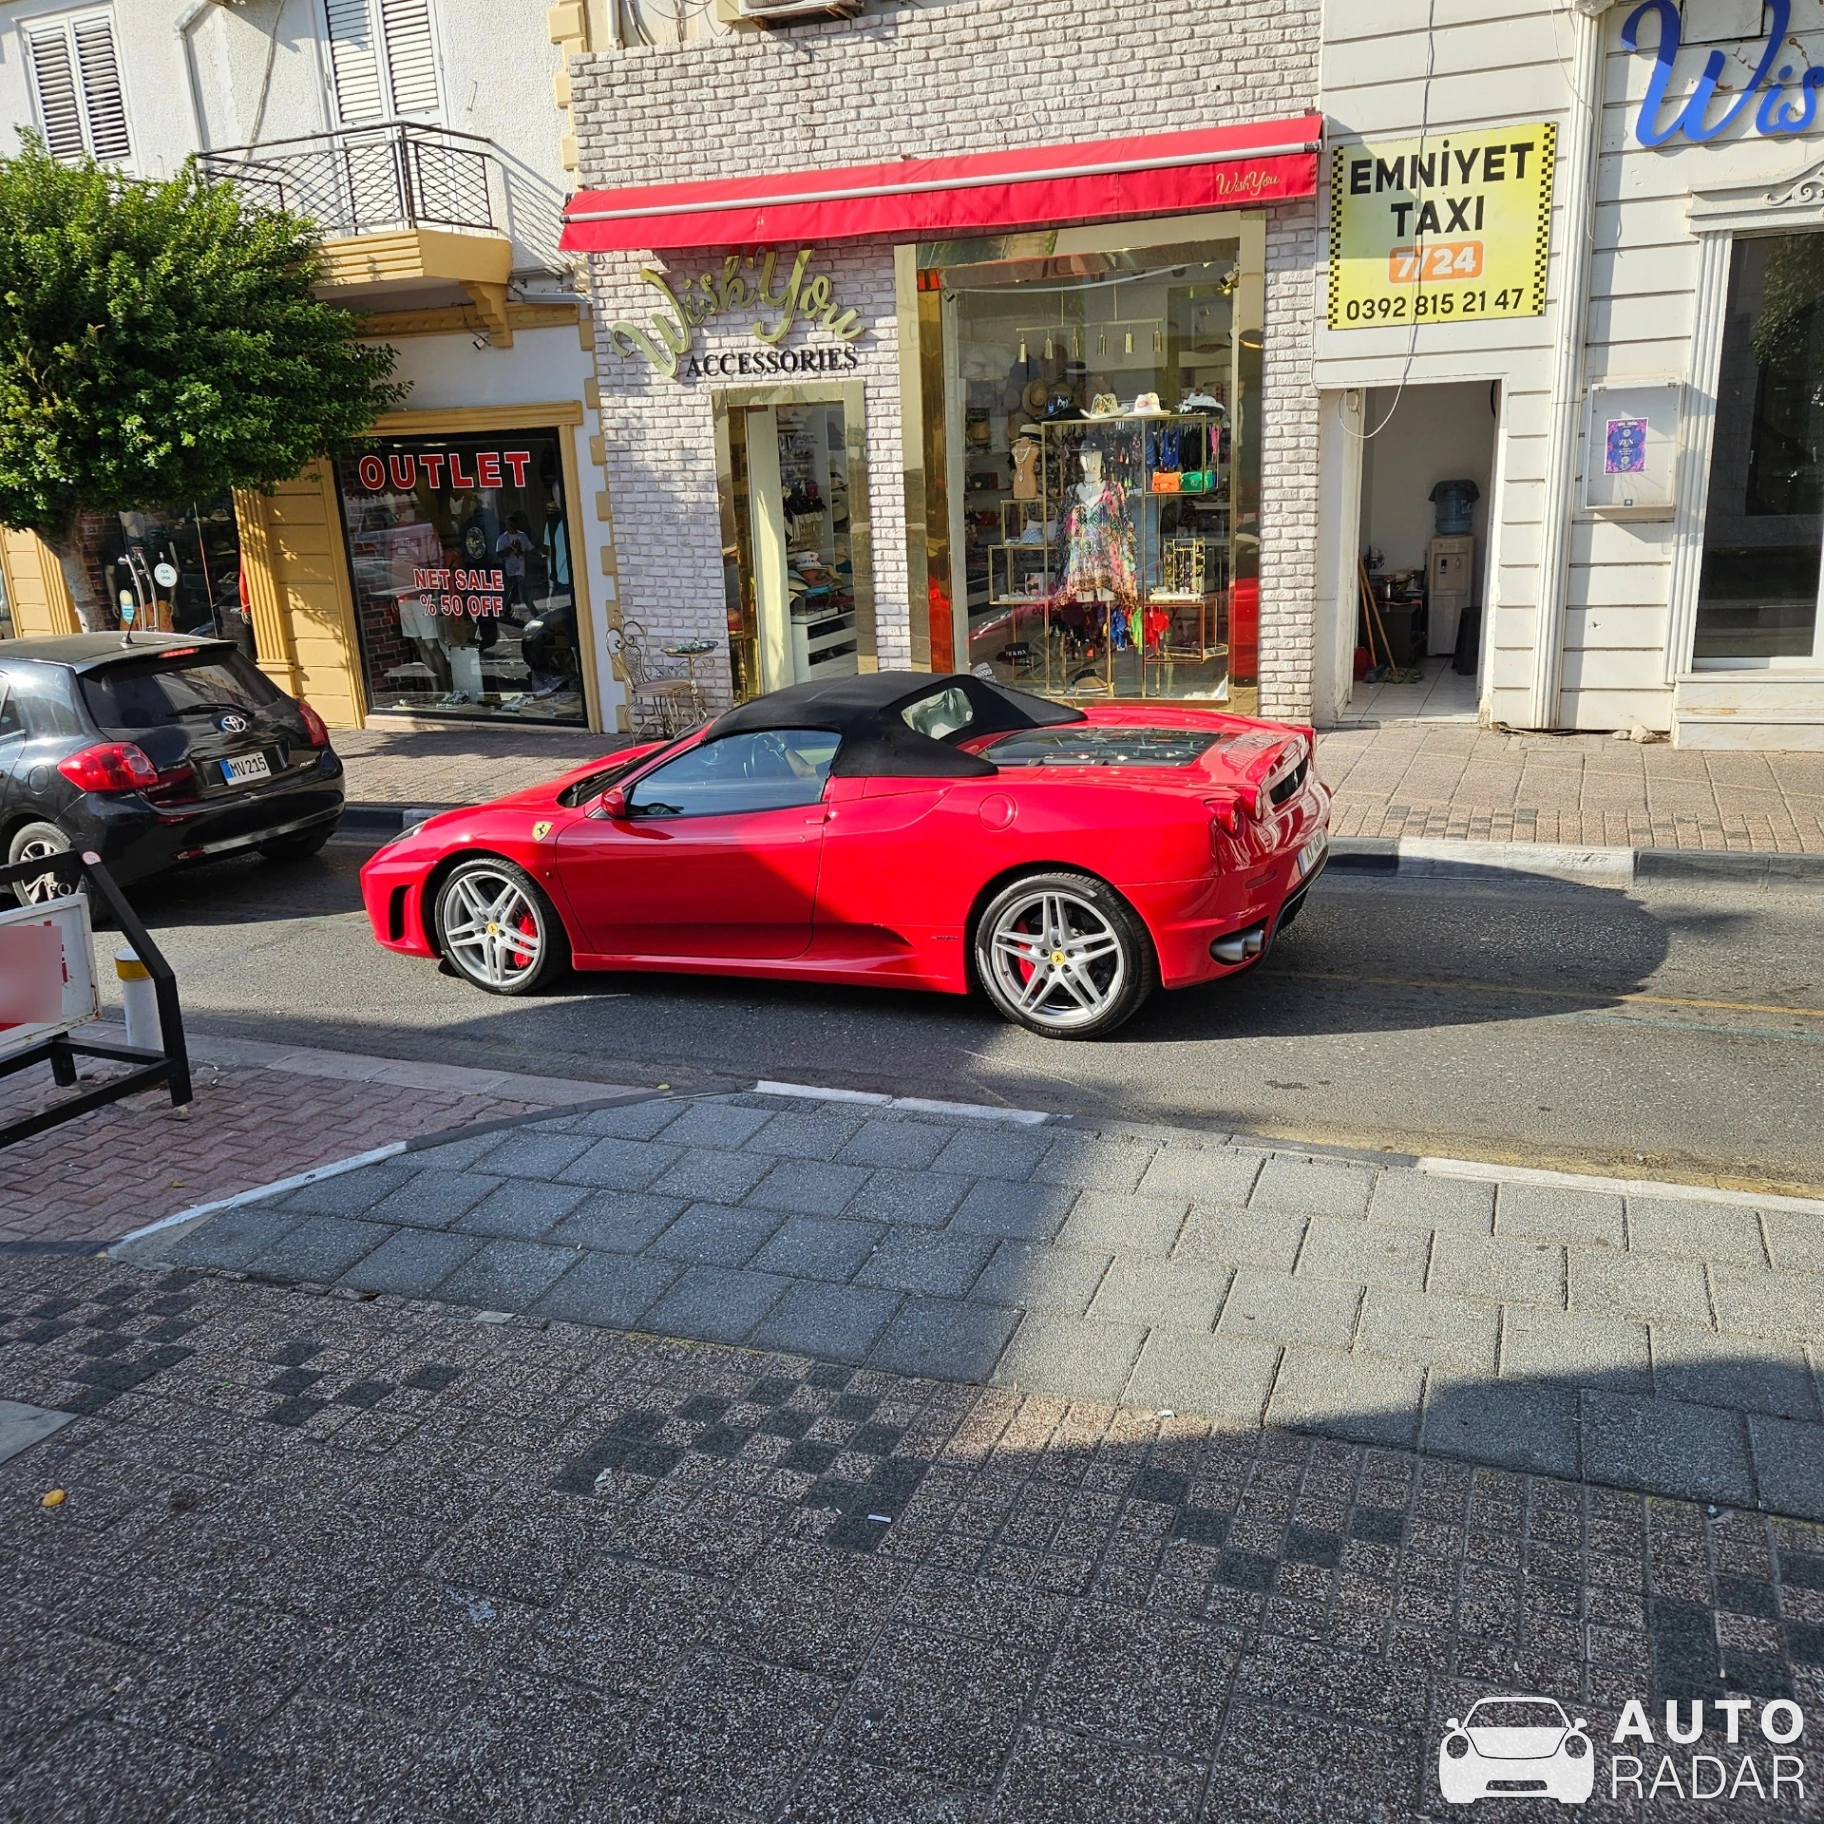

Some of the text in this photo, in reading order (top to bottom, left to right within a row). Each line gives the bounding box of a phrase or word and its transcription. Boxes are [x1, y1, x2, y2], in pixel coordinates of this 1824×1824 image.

[1350, 140, 1534, 195] EMNİYET
[1390, 195, 1485, 237] TAXI
[1396, 246, 1477, 279] 7/24
[1346, 288, 1524, 321] 0392 815 21 47
[686, 346, 858, 378] ACCESSORIES
[359, 451, 530, 490] OUTLET
[413, 568, 504, 591] NET SALE
[420, 595, 503, 617] % 50 OFF
